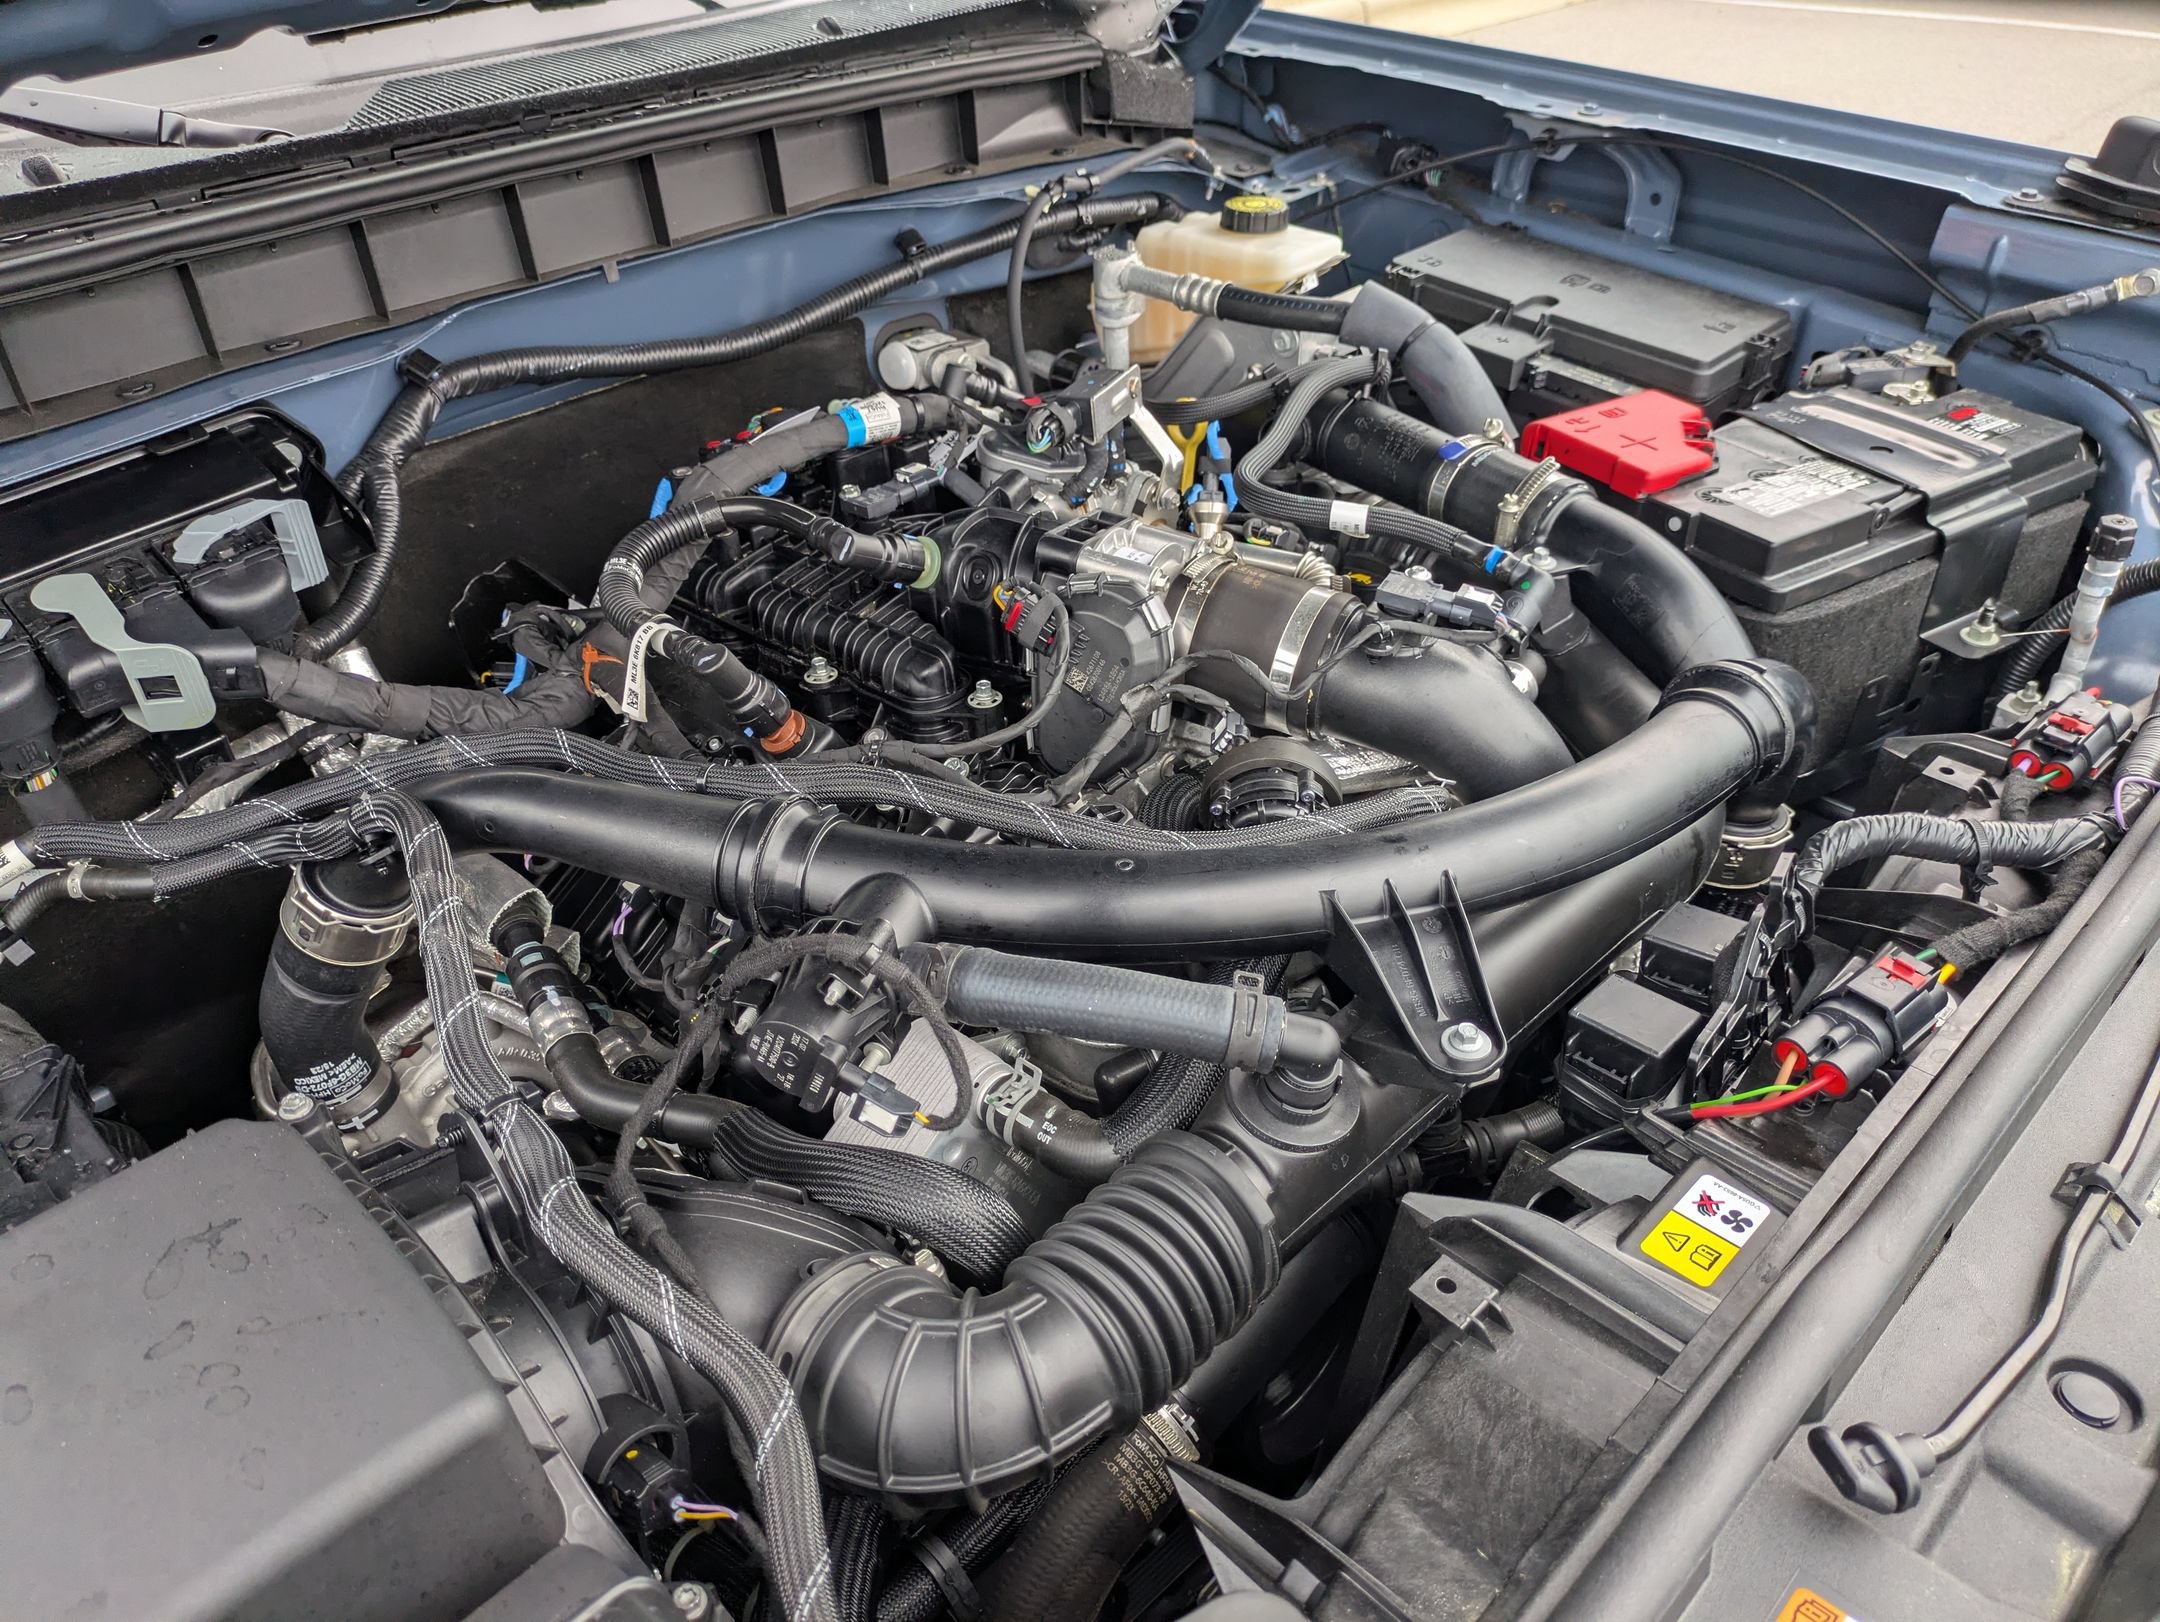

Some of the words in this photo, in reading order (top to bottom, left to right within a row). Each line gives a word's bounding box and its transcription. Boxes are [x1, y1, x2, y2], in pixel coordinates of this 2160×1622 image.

[632, 635, 645, 661] 6K817
[629, 660, 639, 685] ML3E
[293, 1072, 327, 1086] MEXICO
[334, 1066, 369, 1094] FoMoCo
[1036, 1131, 1053, 1145] OUT
[1041, 1121, 1058, 1135] EOC
[1130, 1433, 1161, 1468] FoMoCo
[1117, 1489, 1135, 1512] 15/23
